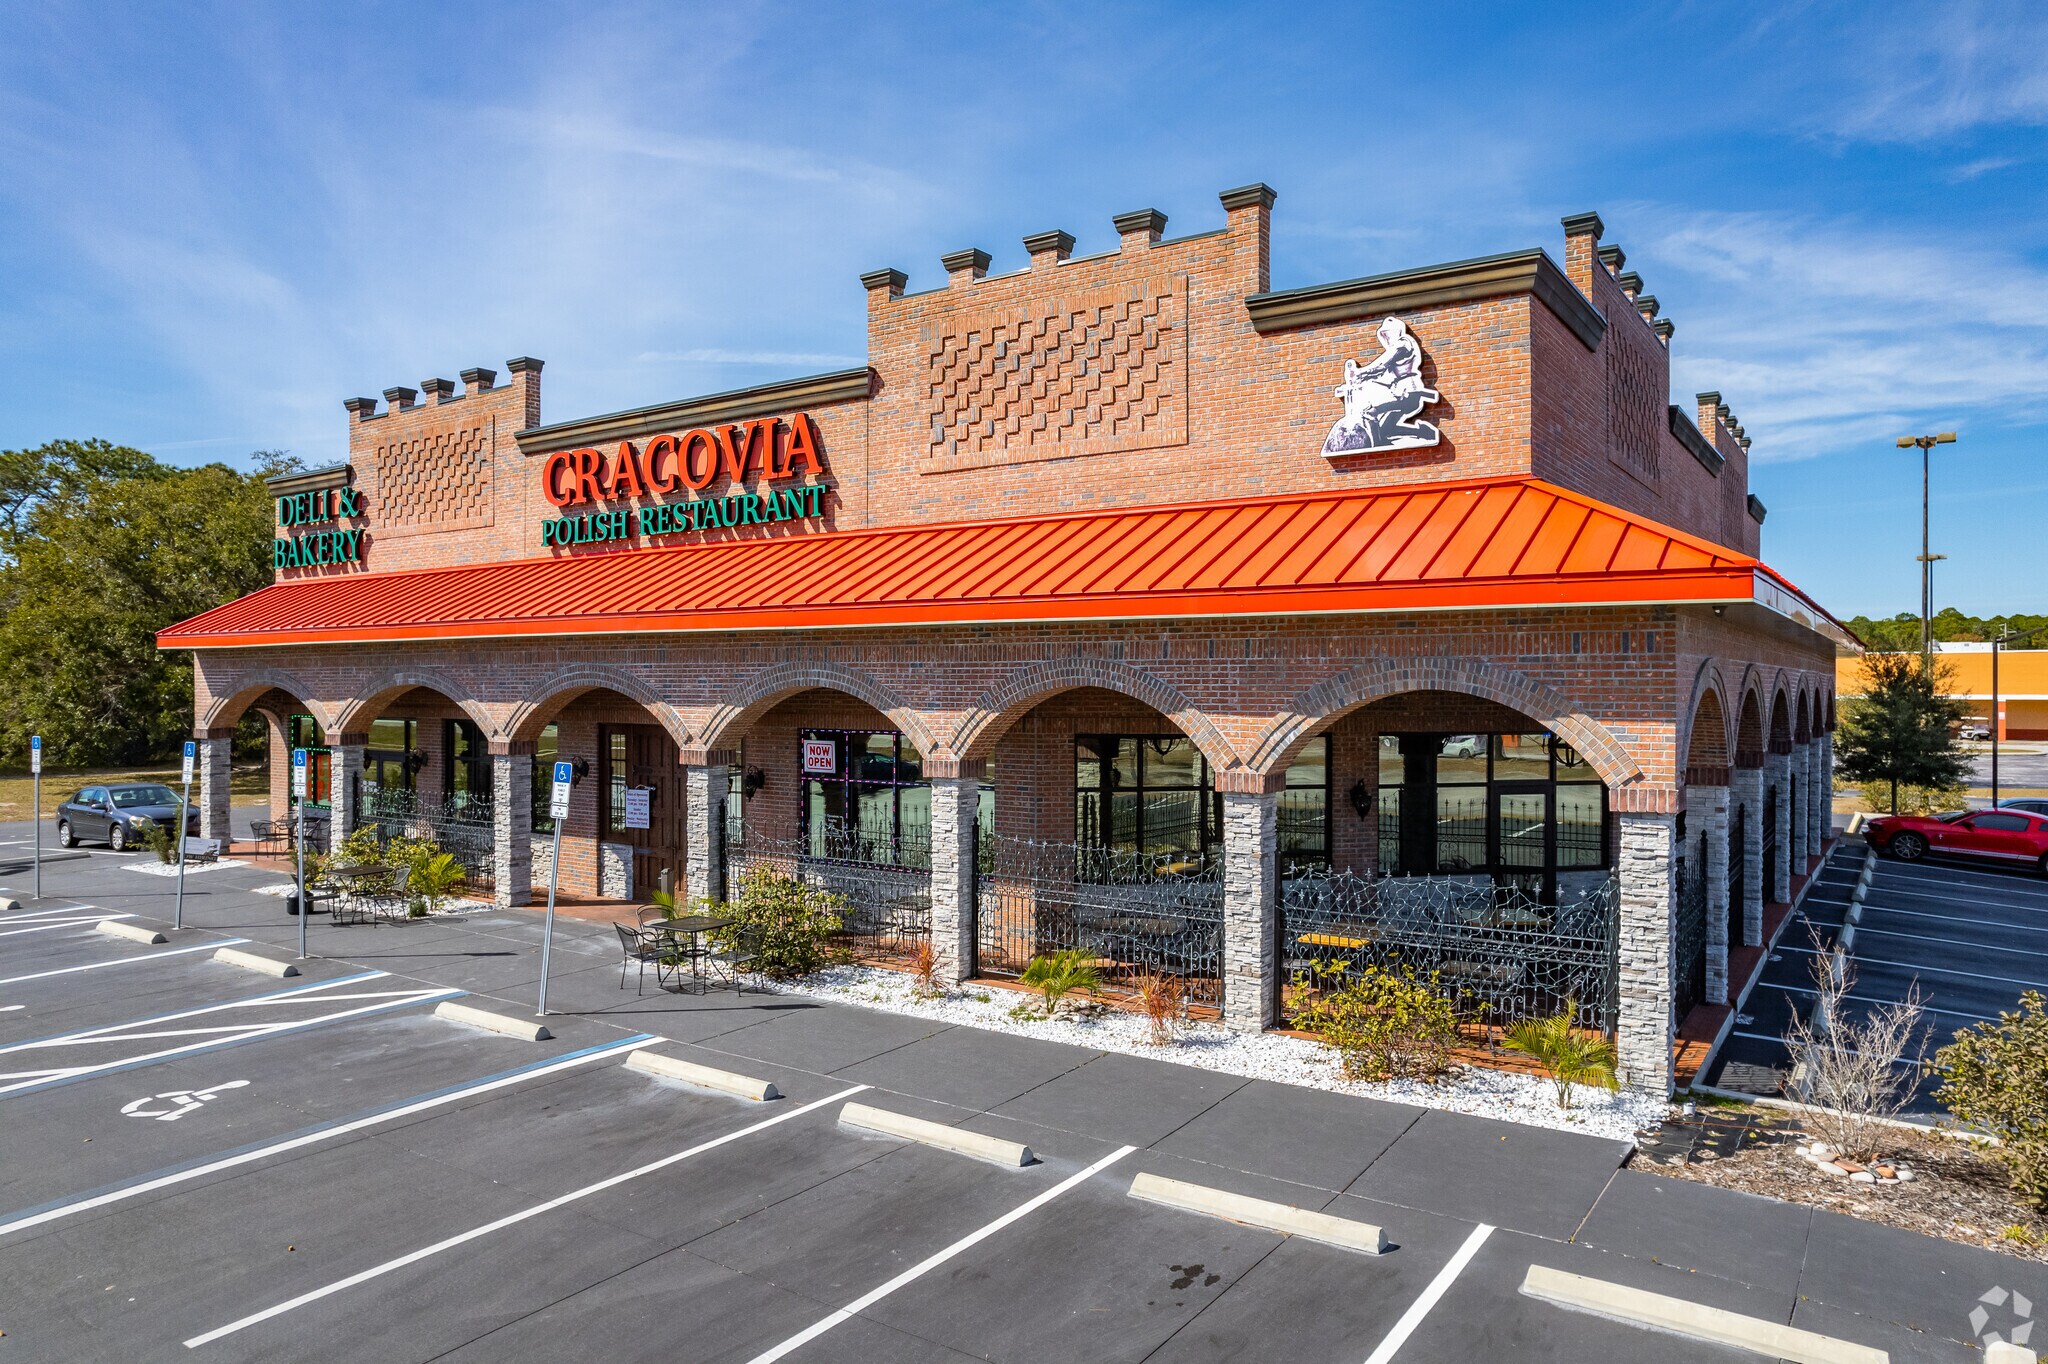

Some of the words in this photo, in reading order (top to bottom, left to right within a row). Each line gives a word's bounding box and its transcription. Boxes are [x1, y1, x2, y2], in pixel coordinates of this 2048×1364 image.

[542, 412, 823, 507] CRACOVIA
[278, 488, 329, 527] DELI
[338, 486, 360, 518] &
[541, 509, 631, 547] POLISH
[638, 484, 827, 537] RESTAURANT
[273, 528, 362, 570] BAKERY
[808, 757, 832, 767] OPEN
[809, 746, 830, 756] NOW
